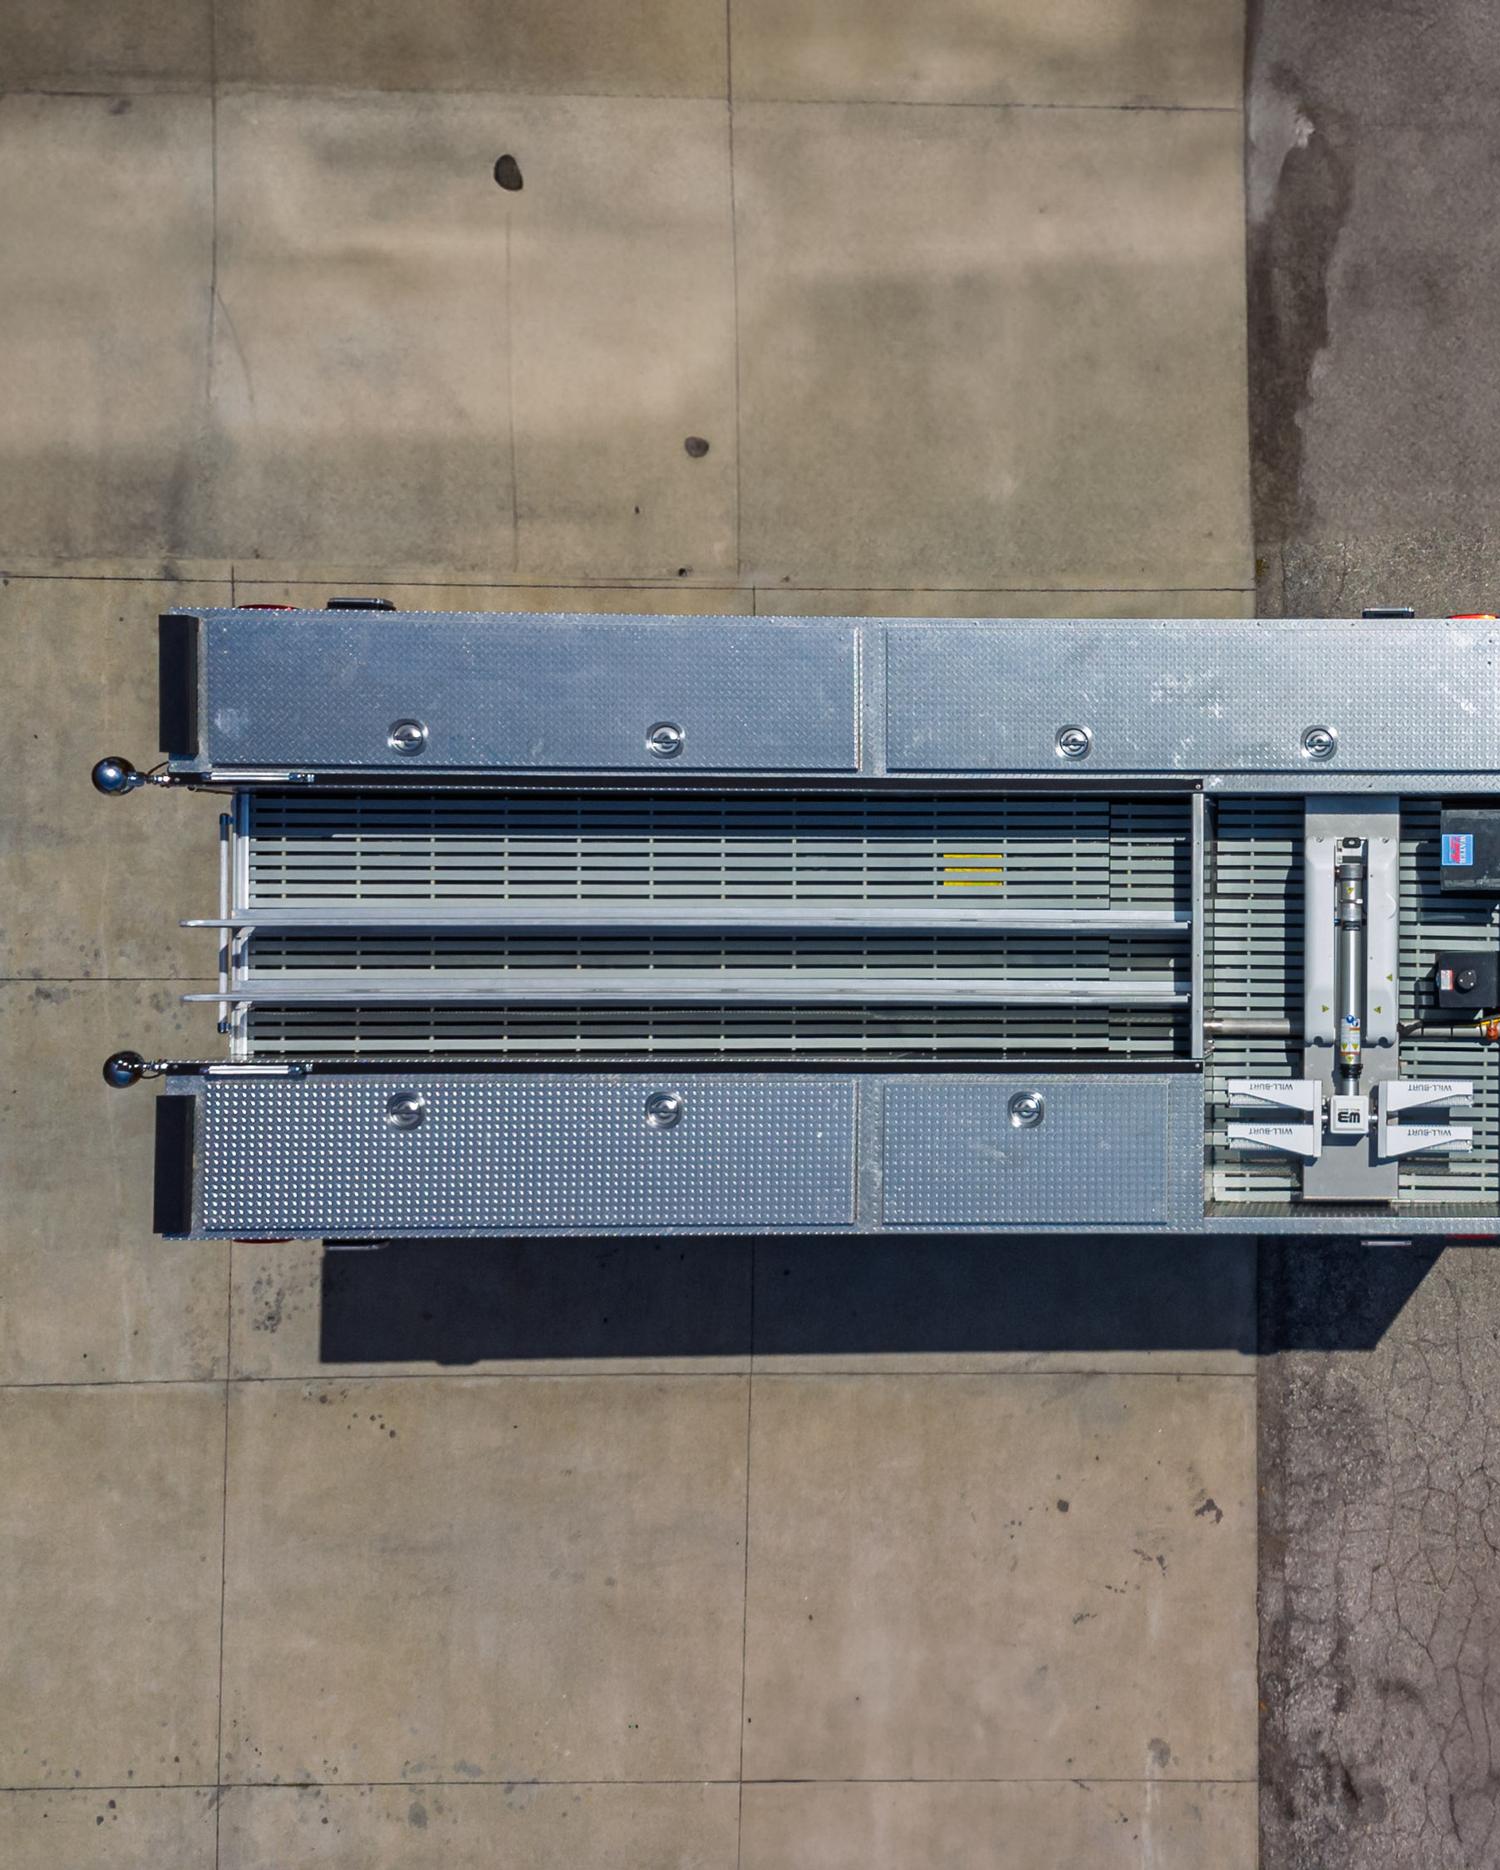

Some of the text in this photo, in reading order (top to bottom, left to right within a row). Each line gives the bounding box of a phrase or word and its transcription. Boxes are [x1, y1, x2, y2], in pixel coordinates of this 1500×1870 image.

[1249, 1083, 1293, 1091] WILL-BURT
[1408, 1084, 1452, 1092] WILL-BURT
[1248, 1127, 1293, 1135] WILL-BURT
